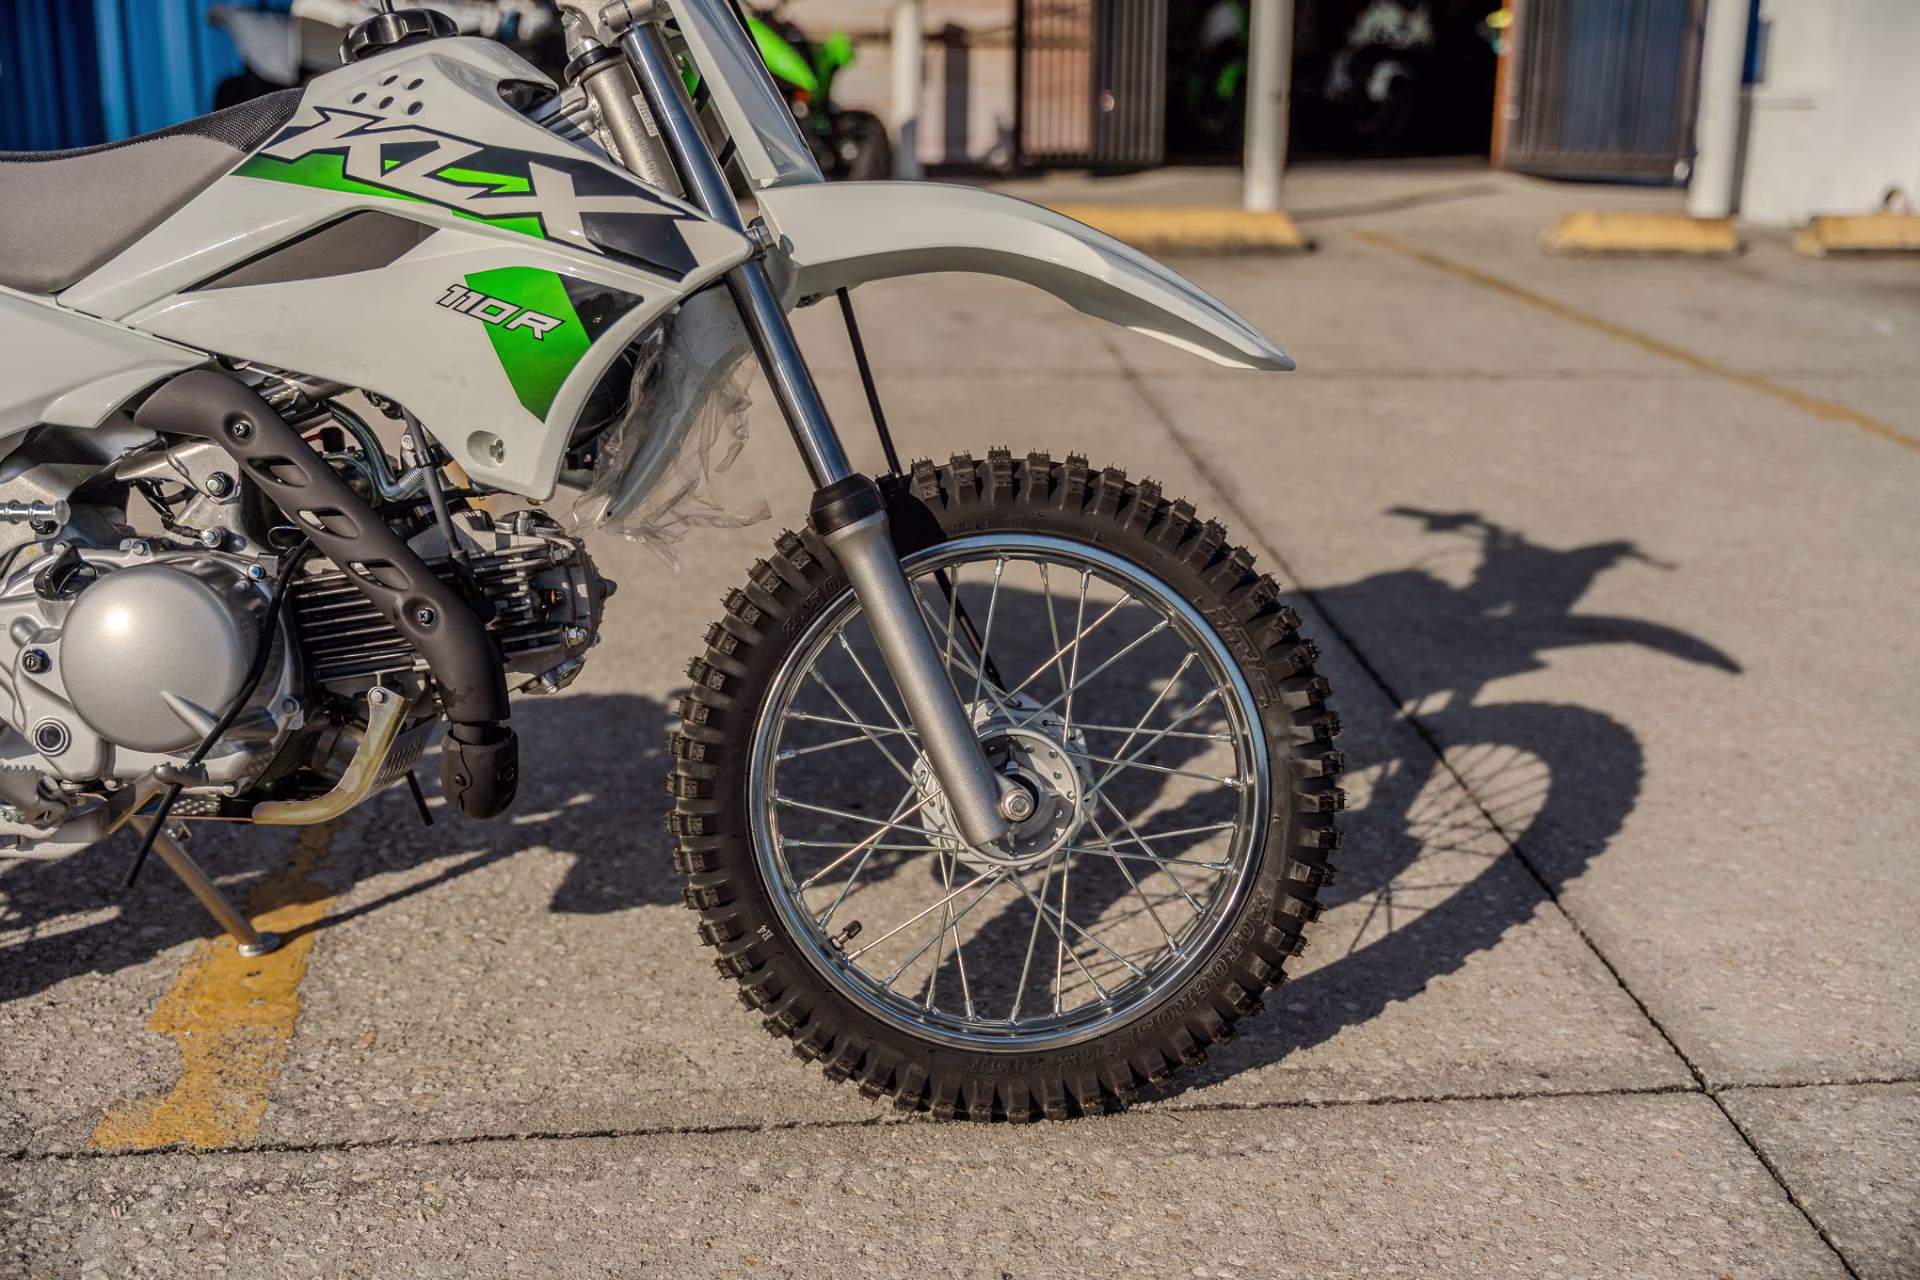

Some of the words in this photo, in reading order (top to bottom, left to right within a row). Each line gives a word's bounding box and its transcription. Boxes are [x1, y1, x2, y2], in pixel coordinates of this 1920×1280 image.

[259, 106, 690, 255] KLX
[436, 283, 565, 341] 110R
[1116, 894, 1270, 1050] MOTOCROSS
